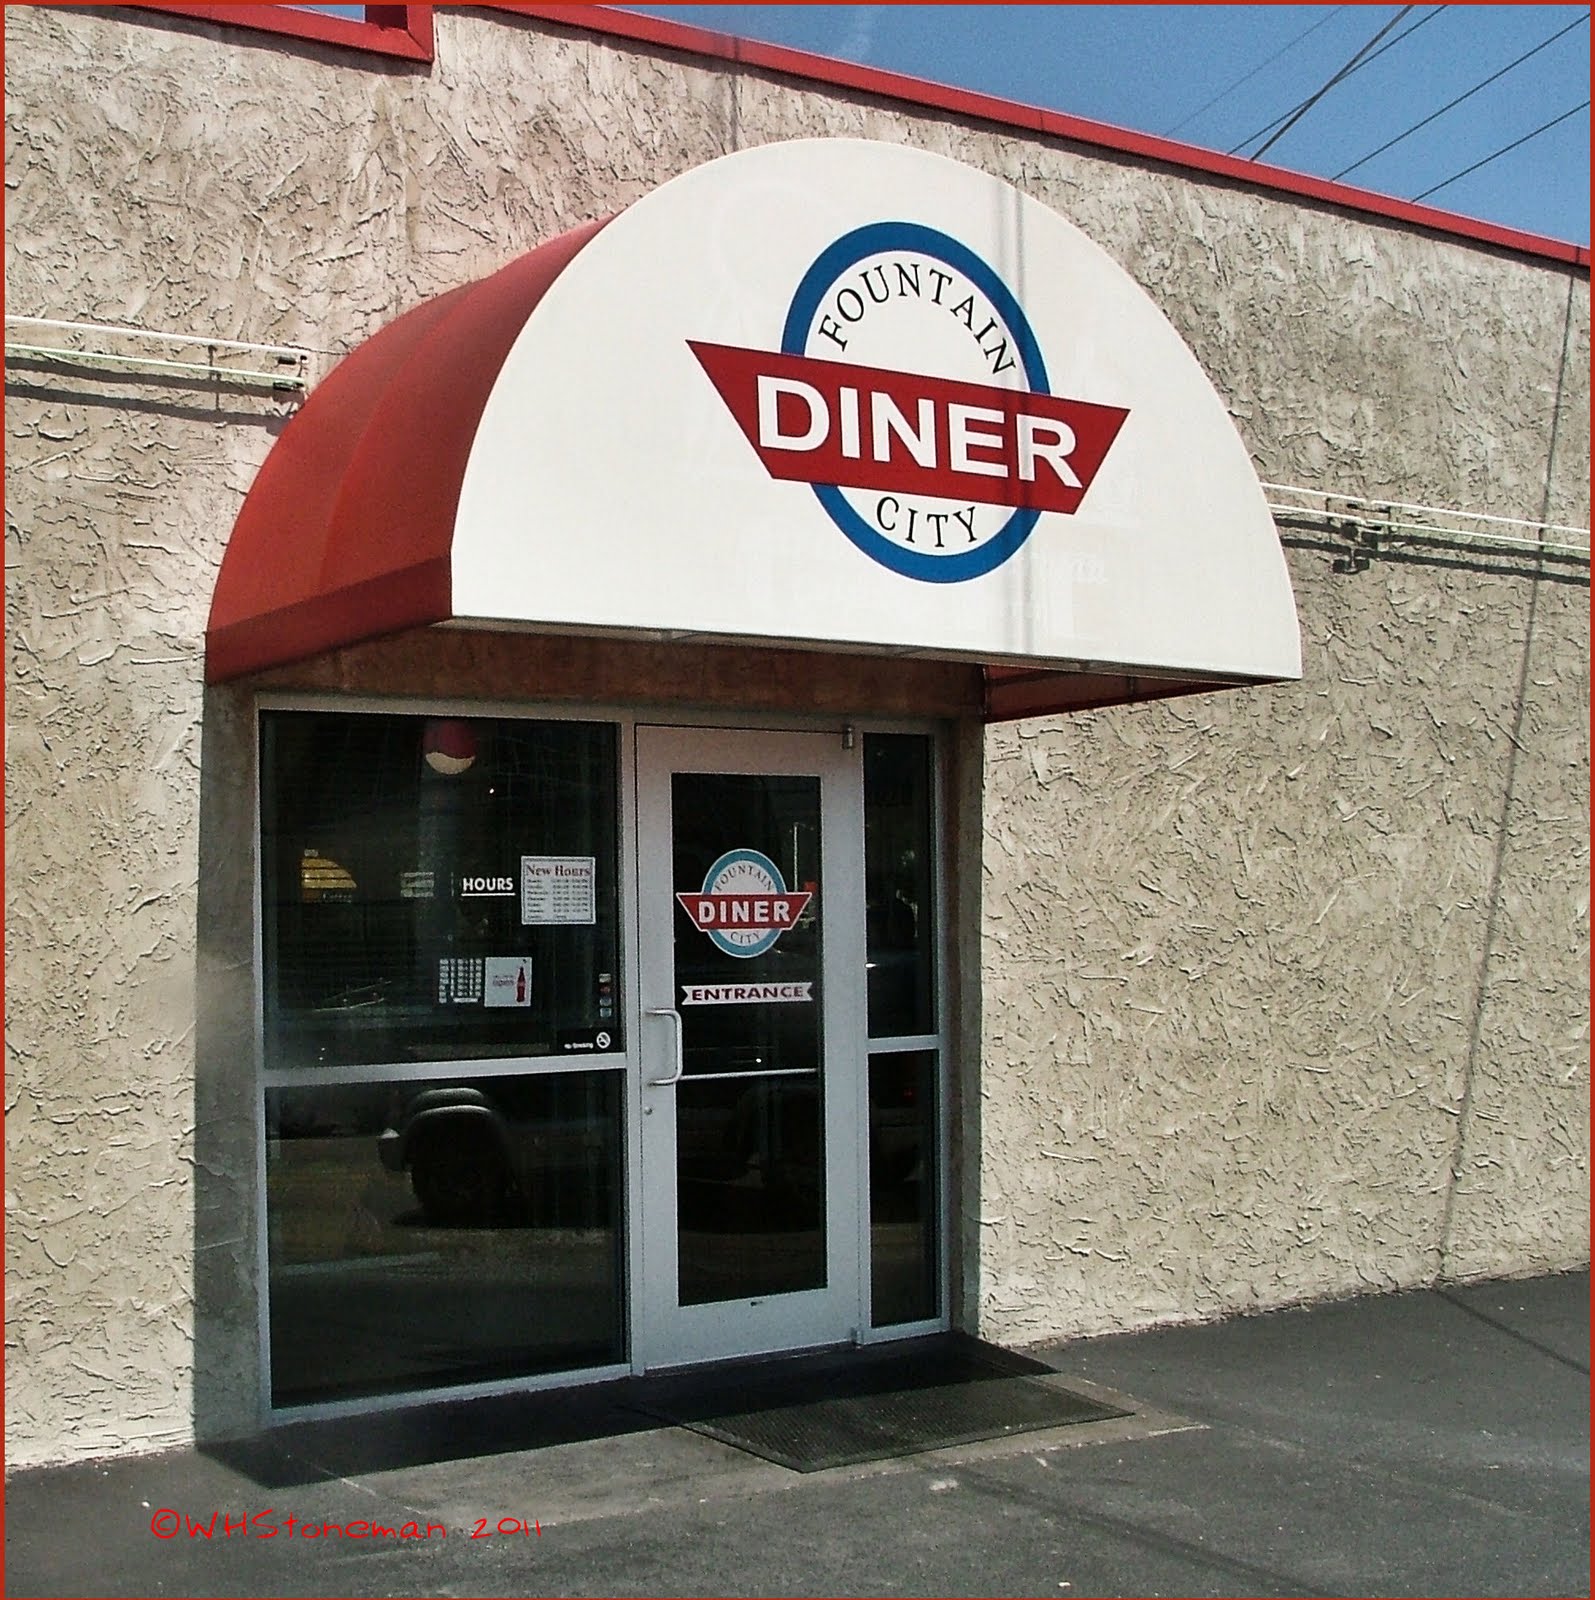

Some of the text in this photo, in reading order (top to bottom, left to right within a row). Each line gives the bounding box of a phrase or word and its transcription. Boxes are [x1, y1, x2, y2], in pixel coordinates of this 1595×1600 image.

[818, 262, 1018, 375] FOUNTAIN
[756, 374, 1084, 490] DINER
[876, 495, 978, 548] CITY
[526, 864, 592, 877] New Hours
[714, 864, 773, 892] FOUNTAIN
[462, 877, 514, 892] HOURS
[698, 900, 791, 923] DINER
[730, 931, 761, 944] CITY
[692, 986, 804, 1001] ENTRANCE
